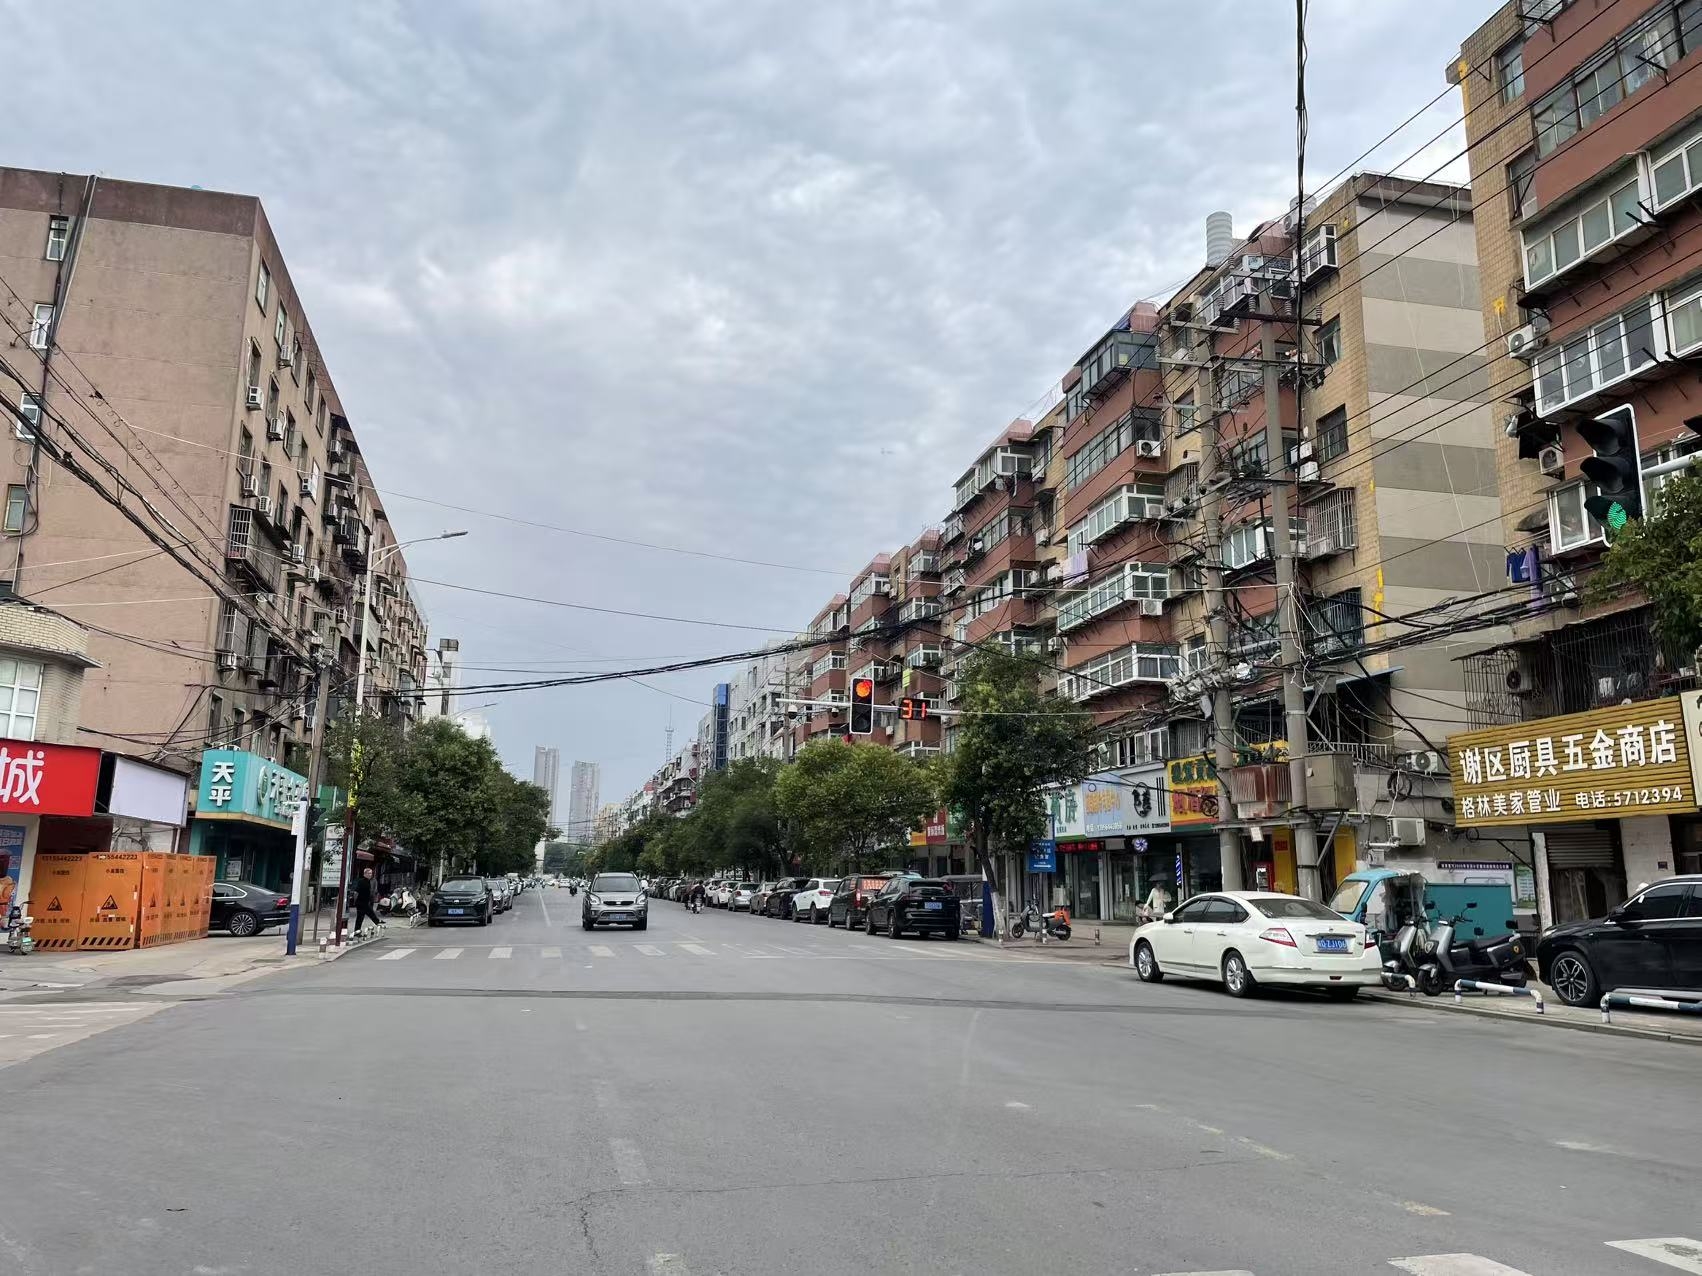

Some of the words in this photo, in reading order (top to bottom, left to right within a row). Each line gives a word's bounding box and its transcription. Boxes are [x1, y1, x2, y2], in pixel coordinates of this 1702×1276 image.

[902, 699, 926, 719] 31
[1458, 719, 1677, 785] 谢区厨具五金商店
[0, 747, 45, 805] 城
[208, 761, 235, 807] 天平
[1461, 788, 1561, 819] 格林美家管业
